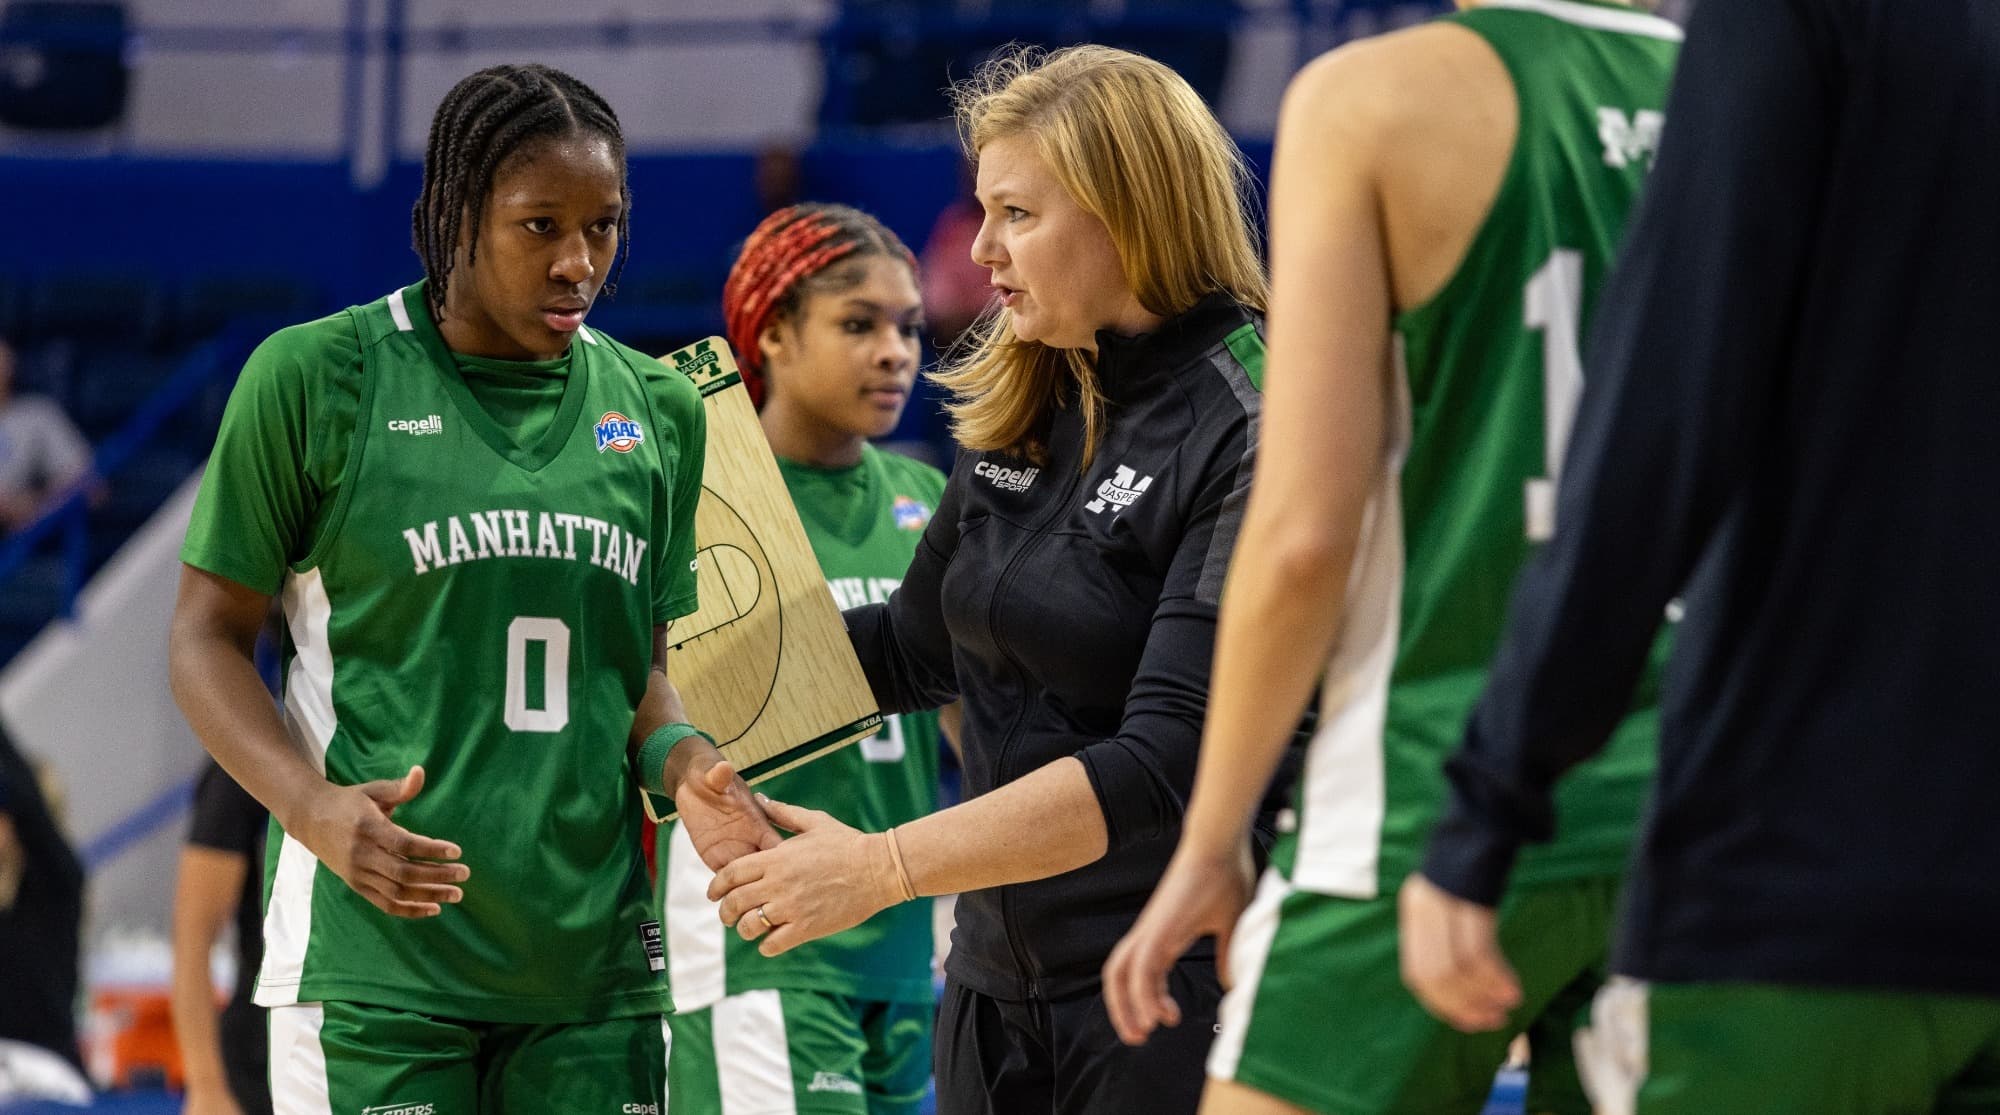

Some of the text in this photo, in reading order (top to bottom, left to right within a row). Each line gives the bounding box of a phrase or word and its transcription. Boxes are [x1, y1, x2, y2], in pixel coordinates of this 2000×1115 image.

[680, 352, 716, 375] JASPERS
[388, 414, 443, 435] capelli
[594, 421, 642, 448] MAAC
[974, 460, 1040, 487] capelli
[995, 480, 1029, 493] SPORT
[402, 508, 648, 586] MANHATTAN
[503, 614, 571, 733] 0
